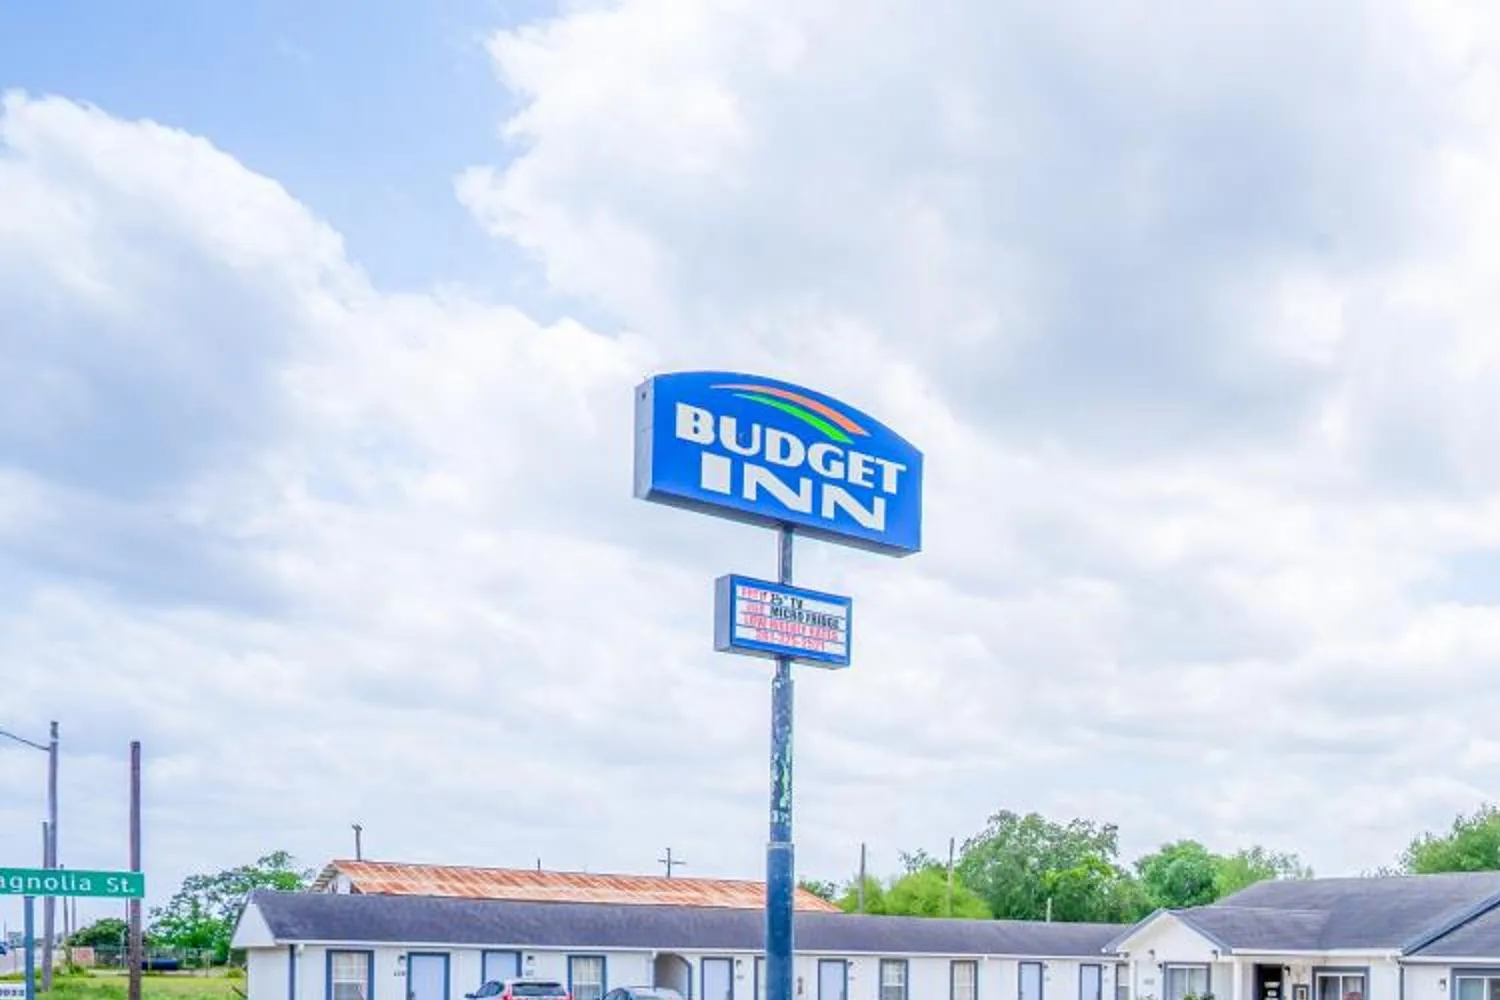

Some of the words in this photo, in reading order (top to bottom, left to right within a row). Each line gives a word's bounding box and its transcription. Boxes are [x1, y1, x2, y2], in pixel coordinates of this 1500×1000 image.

[675, 402, 906, 494] BUDGET
[700, 451, 885, 531] INN
[770, 605, 804, 621] MICRO
[106, 876, 136, 893] St.
